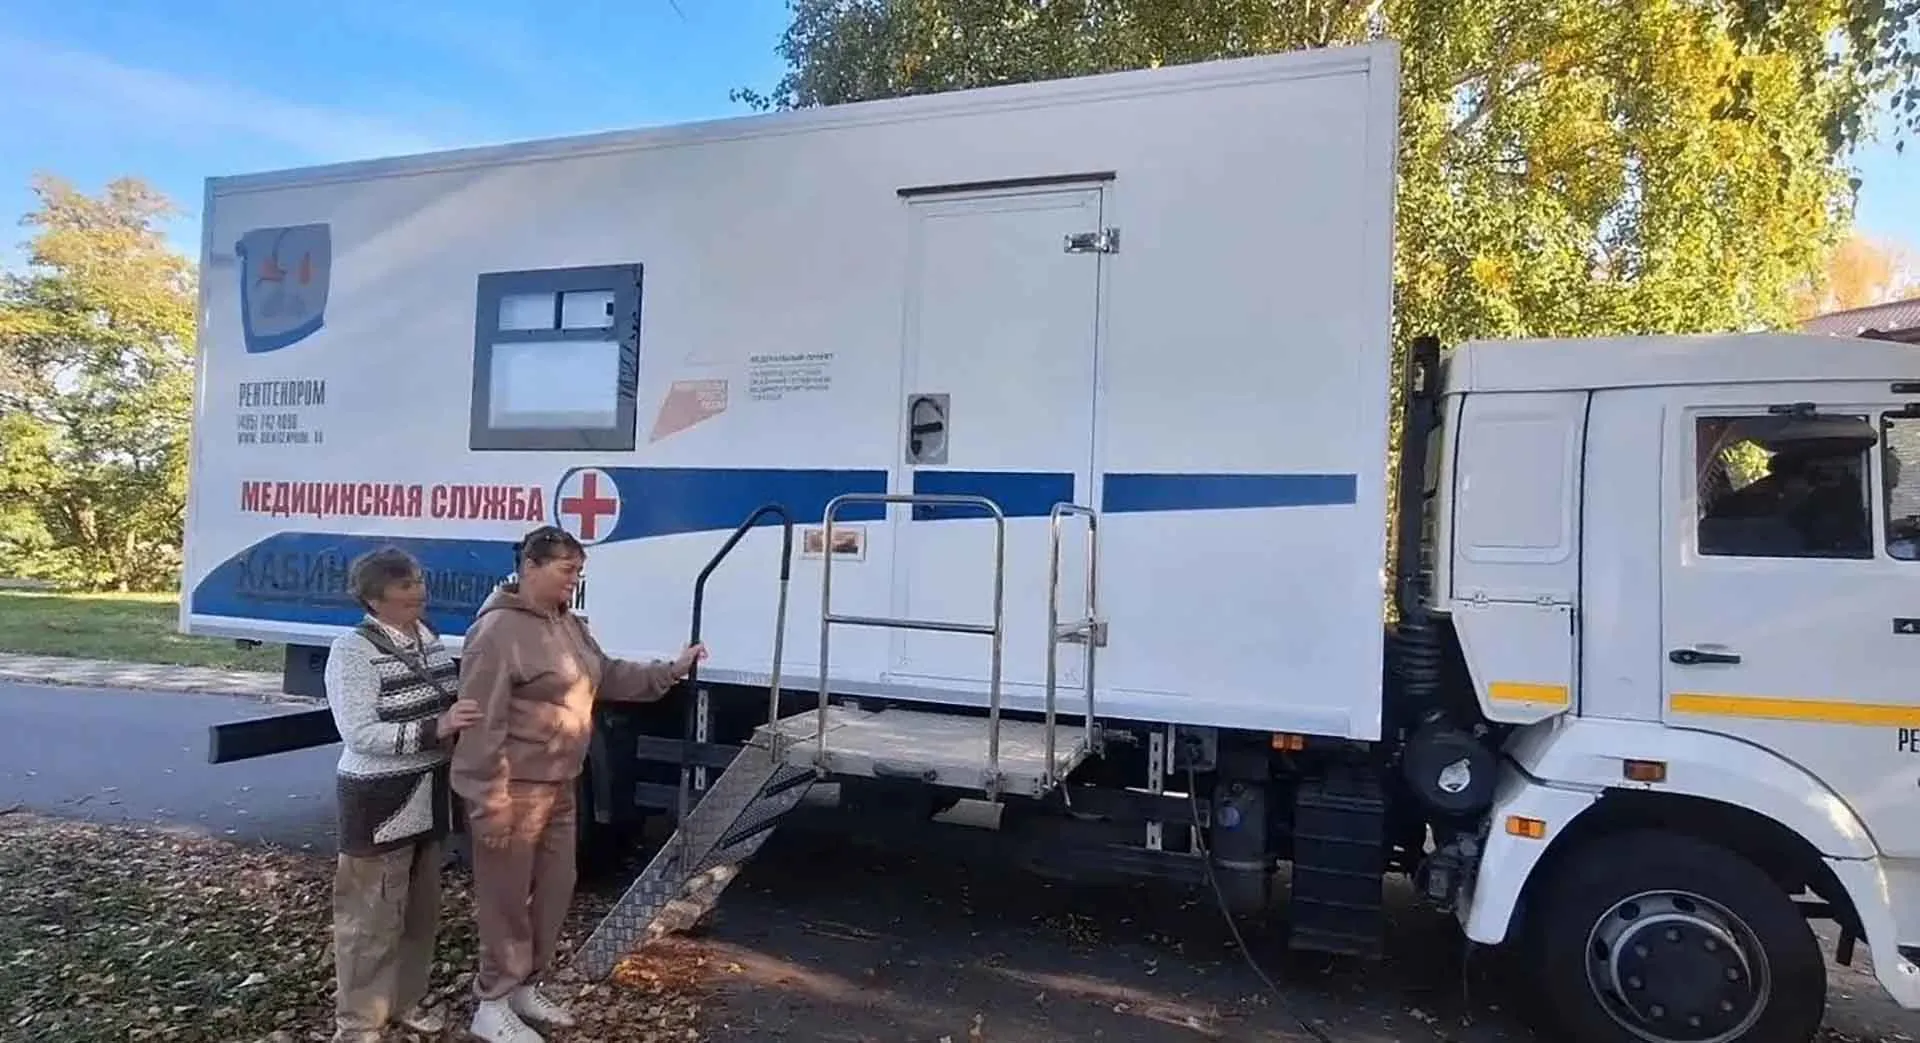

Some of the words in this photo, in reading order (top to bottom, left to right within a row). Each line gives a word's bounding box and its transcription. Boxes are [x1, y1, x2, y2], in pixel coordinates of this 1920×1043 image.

[239, 380, 325, 407] РЕНТГЕНПРОМ
[241, 481, 423, 519] МЕДИЦИНСКАЯ
[431, 484, 544, 521] СЛУЖБА
